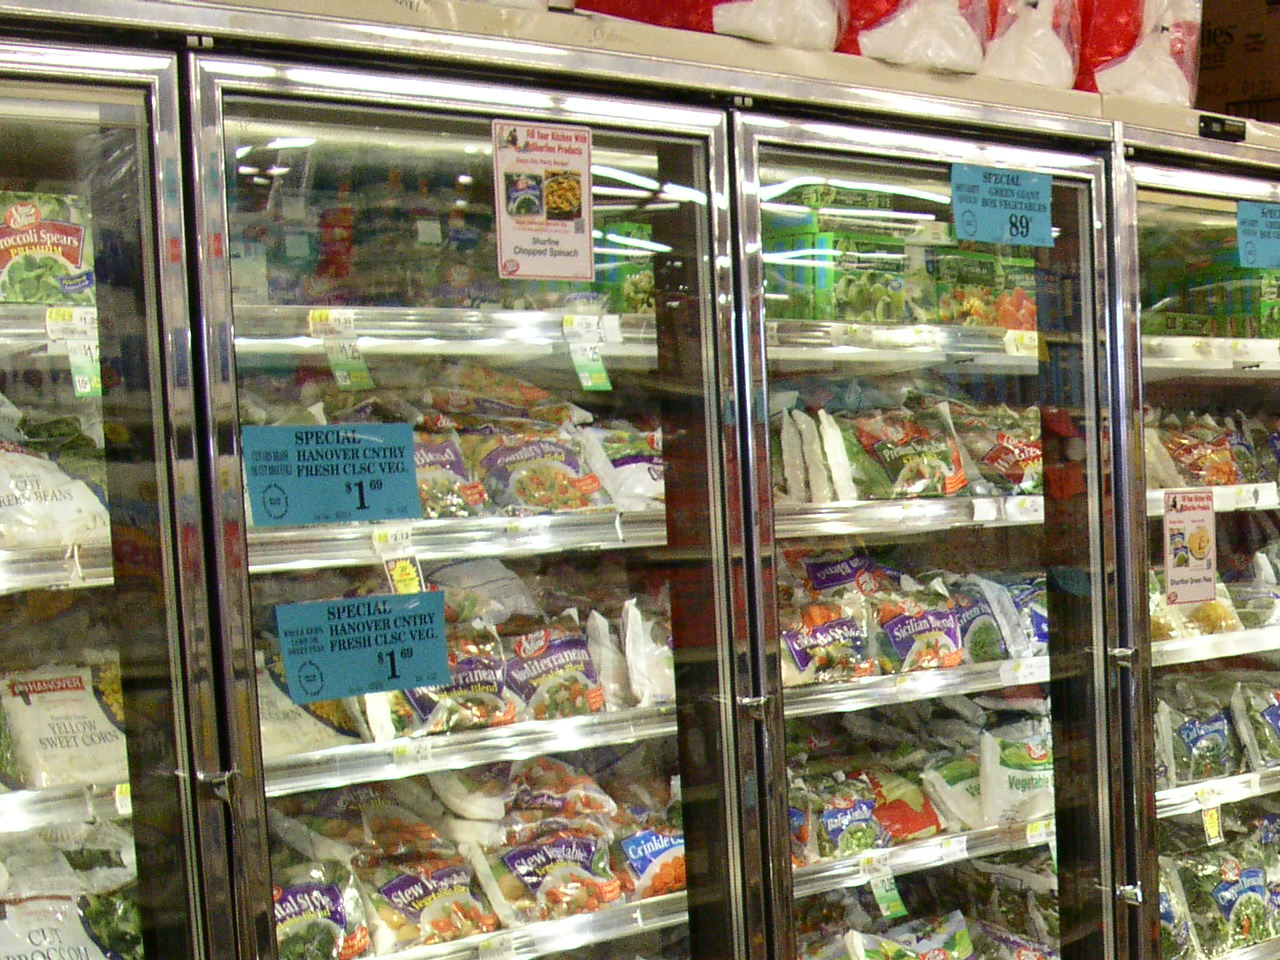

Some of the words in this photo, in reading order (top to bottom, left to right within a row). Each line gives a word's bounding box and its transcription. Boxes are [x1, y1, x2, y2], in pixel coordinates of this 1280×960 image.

[982, 171, 1022, 186] SPECIAL
[989, 187, 1015, 197] GREEN
[1017, 190, 1040, 200] GIANT
[0, 229, 38, 249] roccoli
[40, 229, 79, 248] Spears
[295, 429, 361, 446] SPECIAL
[296, 448, 360, 462] HANOVER
[363, 446, 405, 460] CNTRY
[296, 463, 340, 478] FRESH
[343, 462, 375, 475] CLSC
[327, 601, 392, 620] SPECIAL
[329, 619, 391, 637] HANOVER
[394, 612, 435, 628] CNTRY
[894, 616, 930, 641] Sicilian
[330, 636, 371, 652] FRESH
[374, 631, 406, 647] CLSC
[28, 678, 81, 691] HANOVER
[48, 719, 97, 735] YELLOW
[39, 735, 79, 750] SWEET
[82, 730, 119, 747] CORN
[628, 833, 668, 859] Crinkle
[514, 849, 546, 873] Stew
[391, 880, 424, 906] Stew
[28, 928, 62, 947] CUT
